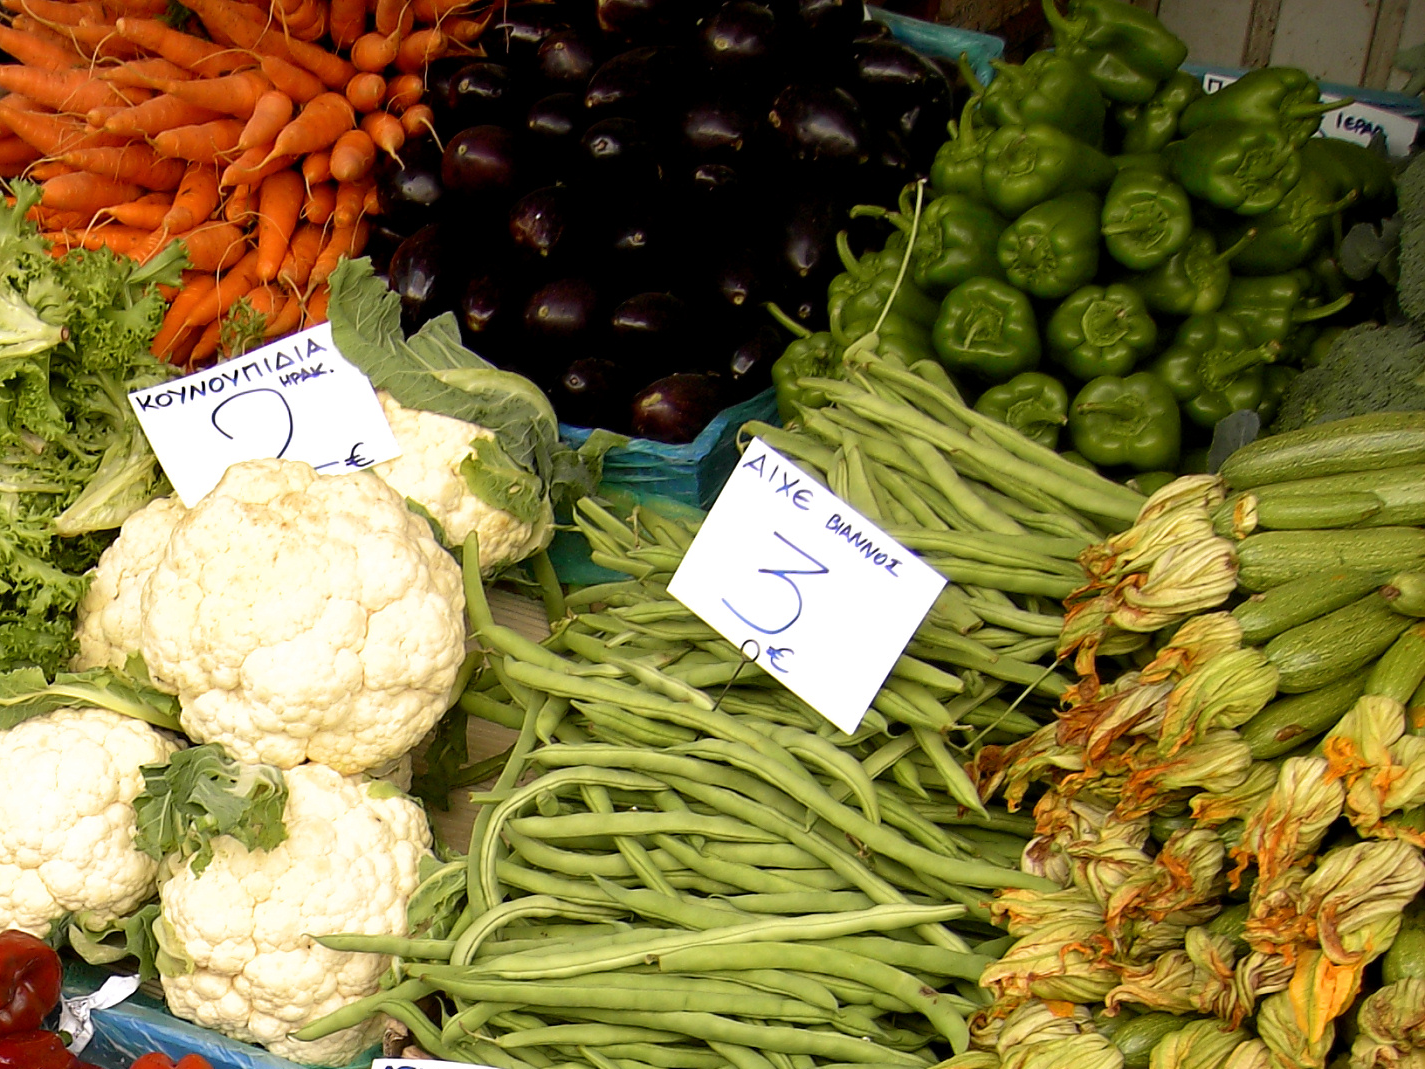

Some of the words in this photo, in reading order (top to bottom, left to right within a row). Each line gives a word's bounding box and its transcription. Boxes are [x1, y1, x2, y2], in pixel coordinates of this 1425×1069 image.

[135, 338, 328, 412] ΚΟΥΝΟΥΠΙΔΙΑ
[742, 453, 814, 511] ΑΙΧΕ
[721, 530, 831, 635] 3
